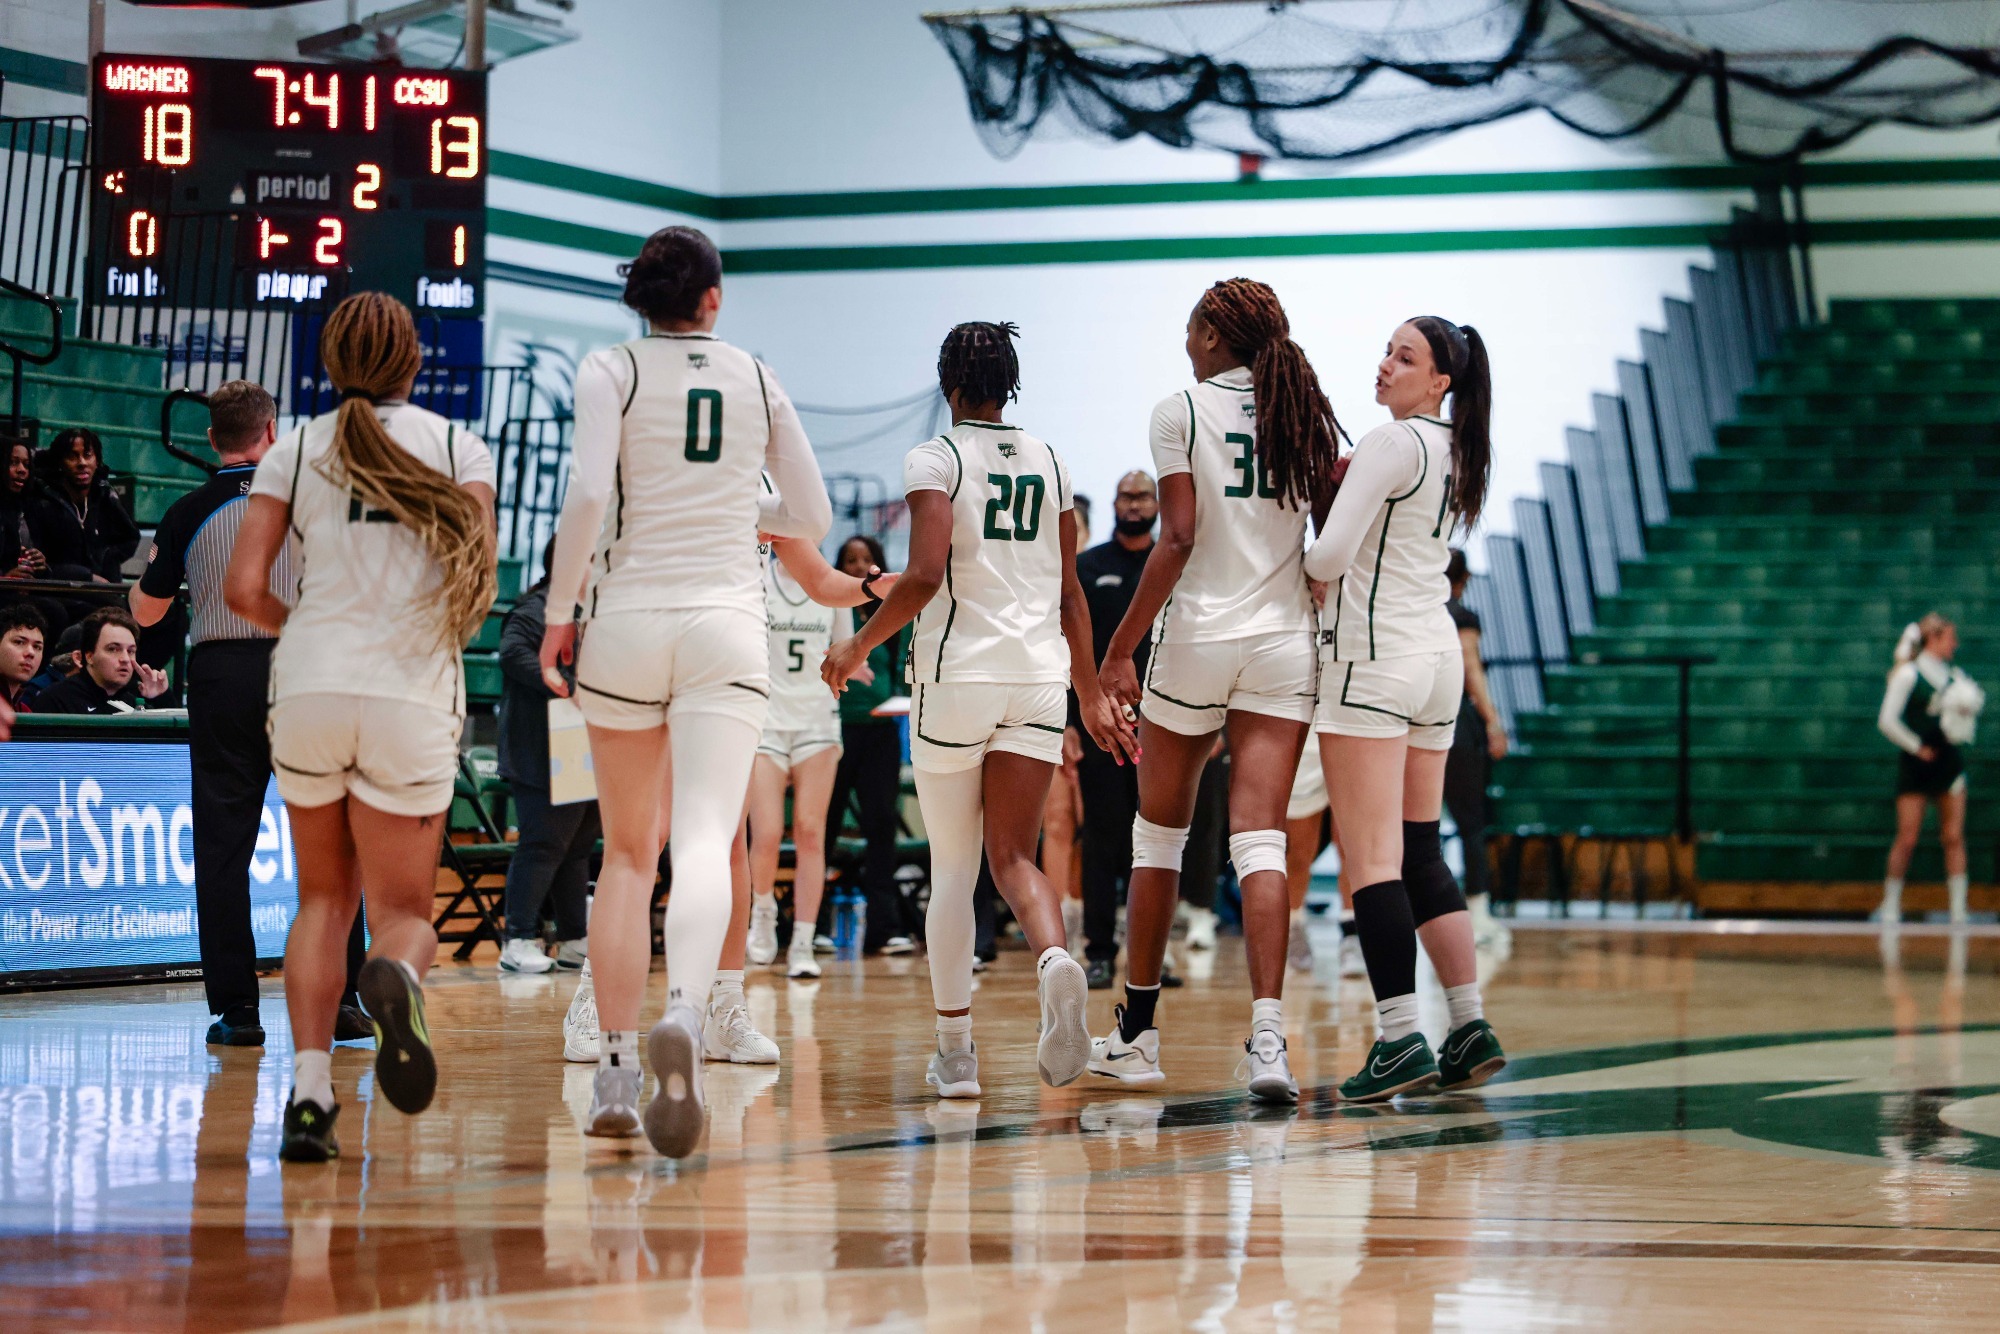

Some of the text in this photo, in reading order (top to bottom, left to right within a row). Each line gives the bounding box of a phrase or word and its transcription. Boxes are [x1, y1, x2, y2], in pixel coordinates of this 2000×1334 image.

[105, 64, 189, 93] WAGNER
[394, 77, 450, 106] CCSU
[143, 103, 192, 165] 18
[431, 116, 480, 178] 13
[256, 173, 331, 202] period
[353, 163, 382, 210] 2
[128, 210, 156, 257] 0
[453, 224, 466, 267] 1
[256, 263, 328, 299] player
[417, 276, 475, 312] fouls
[684, 388, 723, 463] 0
[983, 472, 1045, 541] 20
[787, 639, 805, 672] 5
[3, 908, 28, 942] the
[31, 907, 79, 942] Power
[82, 905, 109, 938] and
[112, 904, 192, 938] Excitement
[250, 903, 288, 934] vents
